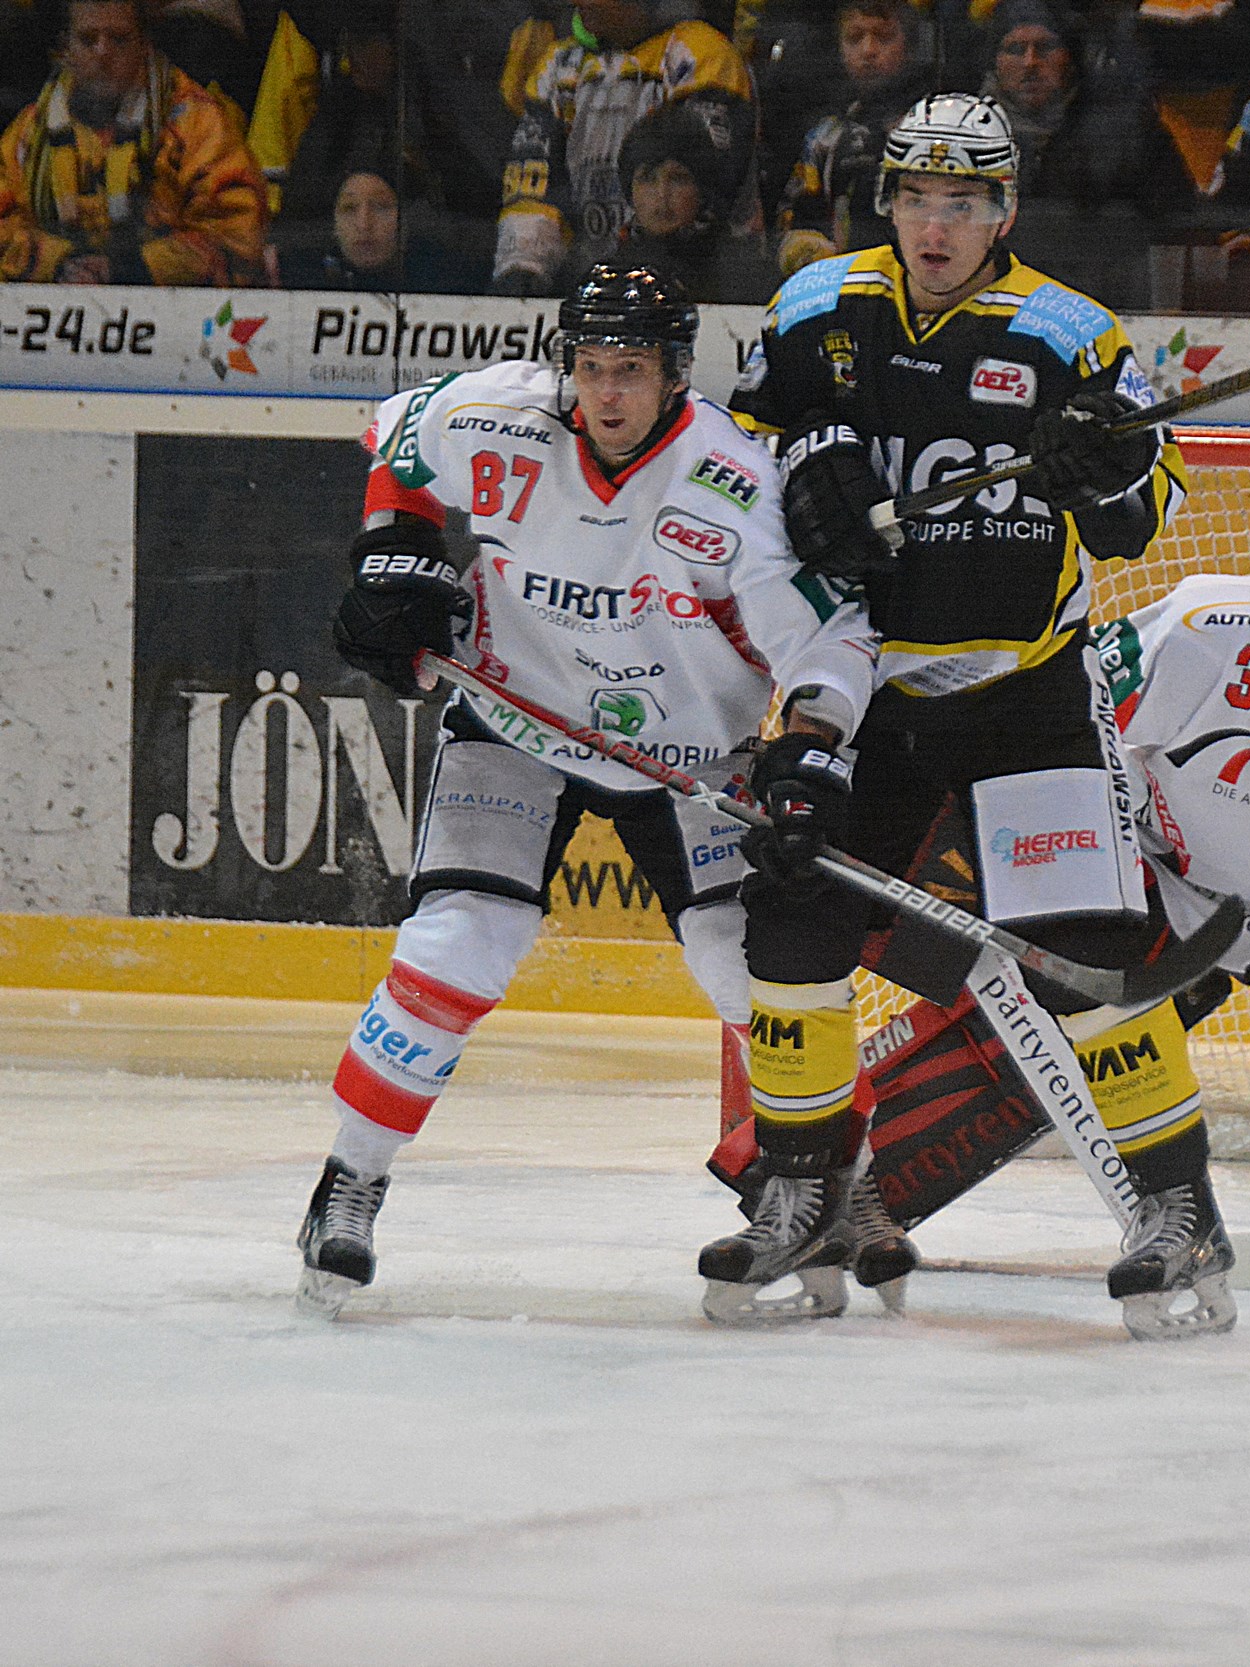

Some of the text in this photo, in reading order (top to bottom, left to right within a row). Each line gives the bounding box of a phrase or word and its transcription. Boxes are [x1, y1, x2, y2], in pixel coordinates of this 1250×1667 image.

[0, 305, 156, 354] -24.de
[1030, 296, 1095, 335] WERKE
[1042, 285, 1107, 326] STADT
[312, 305, 560, 361] Piotrowsk
[1017, 311, 1079, 352] Bayreuth
[448, 416, 553, 445] AUTO KUHL
[471, 449, 543, 524] 87
[695, 456, 759, 504] FFH
[907, 518, 1056, 542] RUPPE STICHT
[361, 554, 460, 586] BAUE
[1091, 621, 1131, 684] cher
[488, 702, 552, 756] MTS
[152, 670, 424, 877] JÖN
[1212, 781, 1238, 800] DIE
[691, 841, 742, 868] Ger
[1011, 828, 1100, 857] HERTEL
[883, 877, 996, 942] BAUER
[750, 1008, 805, 1050] AM
[859, 1016, 916, 1069] GHN
[978, 974, 1144, 1213] partyrent.com
[878, 1095, 1033, 1207] artyren
